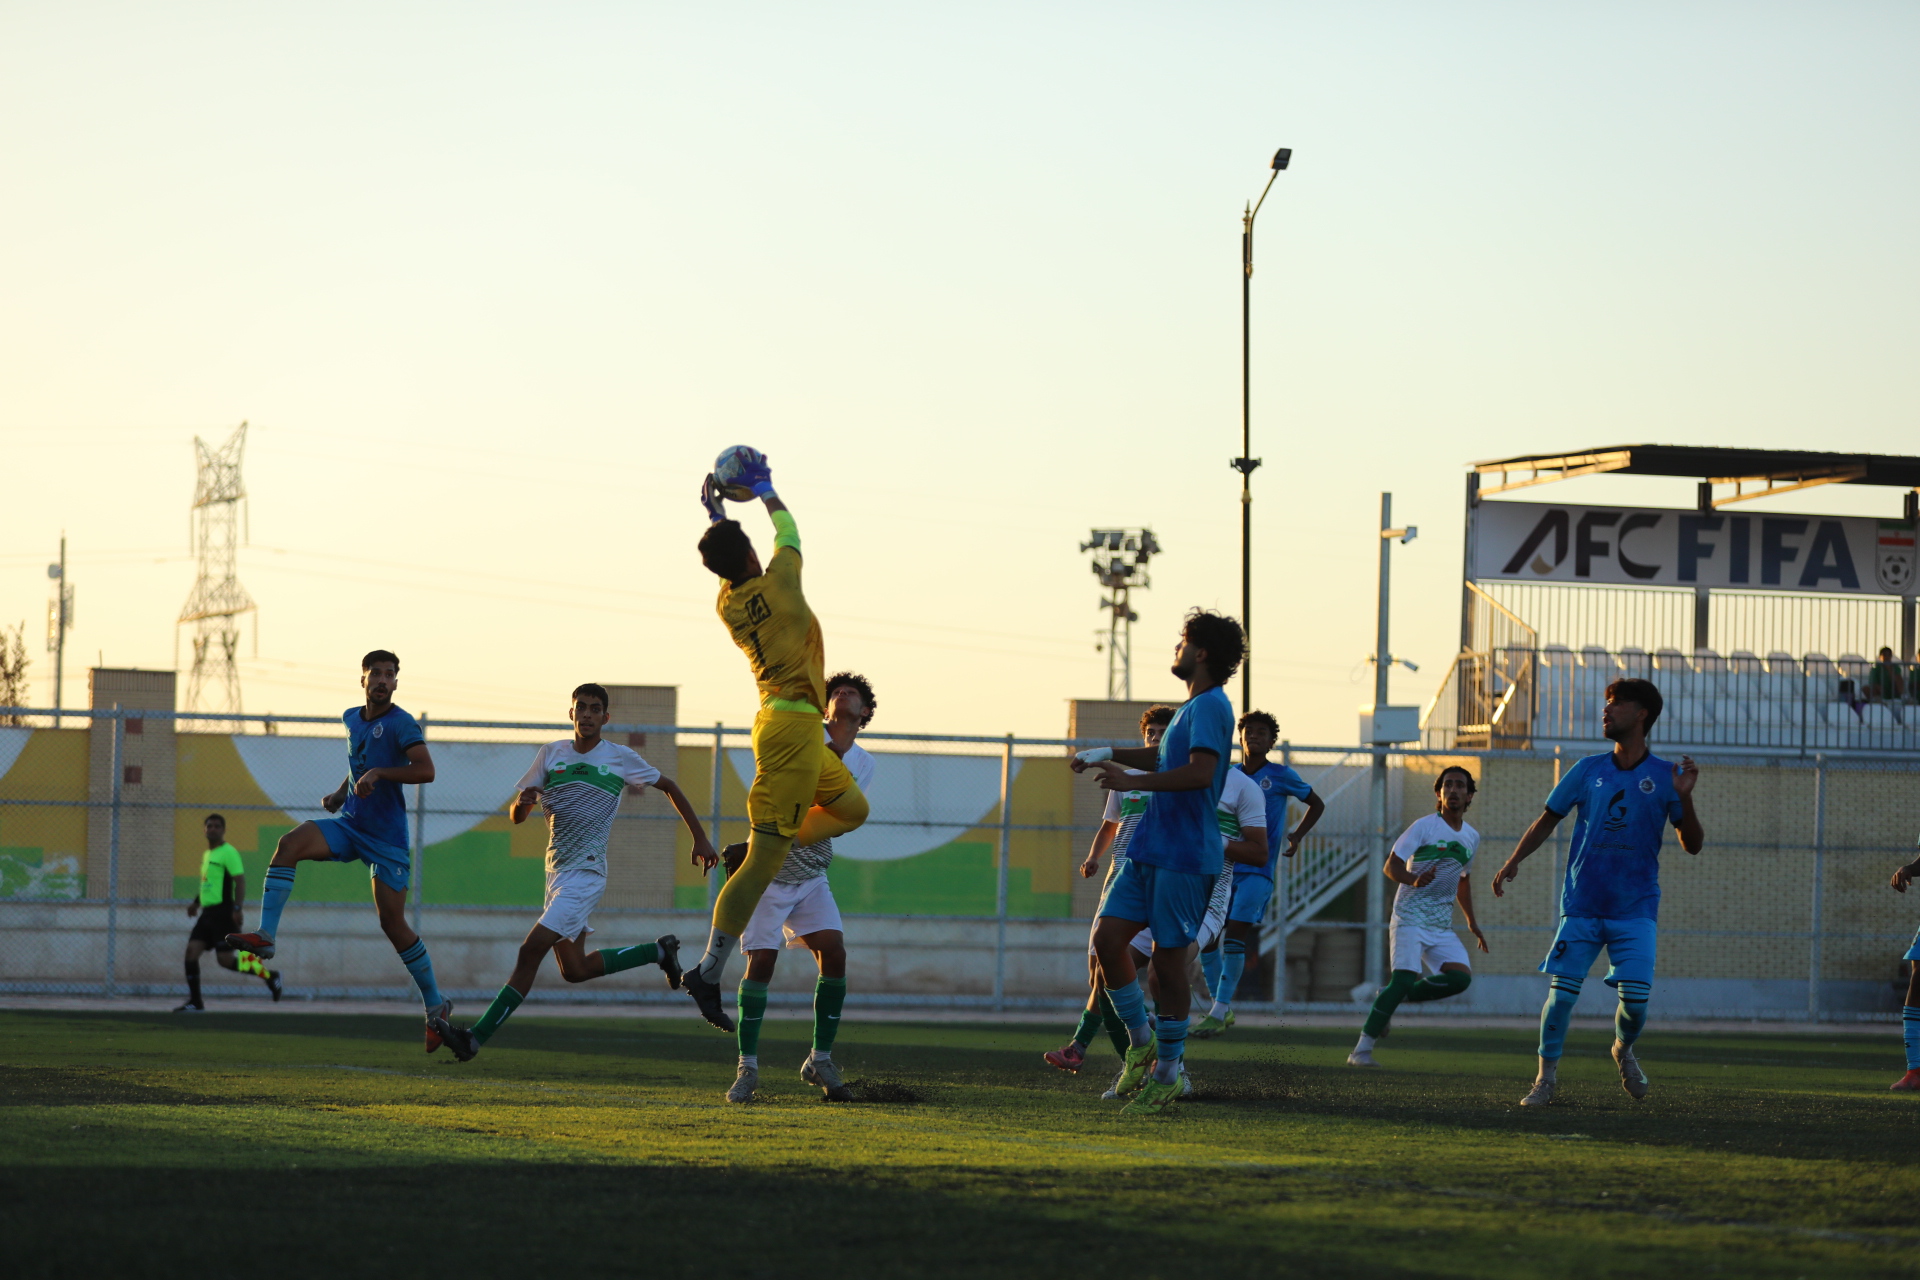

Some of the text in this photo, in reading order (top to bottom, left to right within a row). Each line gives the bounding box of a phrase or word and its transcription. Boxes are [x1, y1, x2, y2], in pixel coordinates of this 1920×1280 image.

[1501, 508, 1861, 589] AFC FIFA
[792, 803, 801, 825] 1
[1553, 940, 1567, 960] 9
